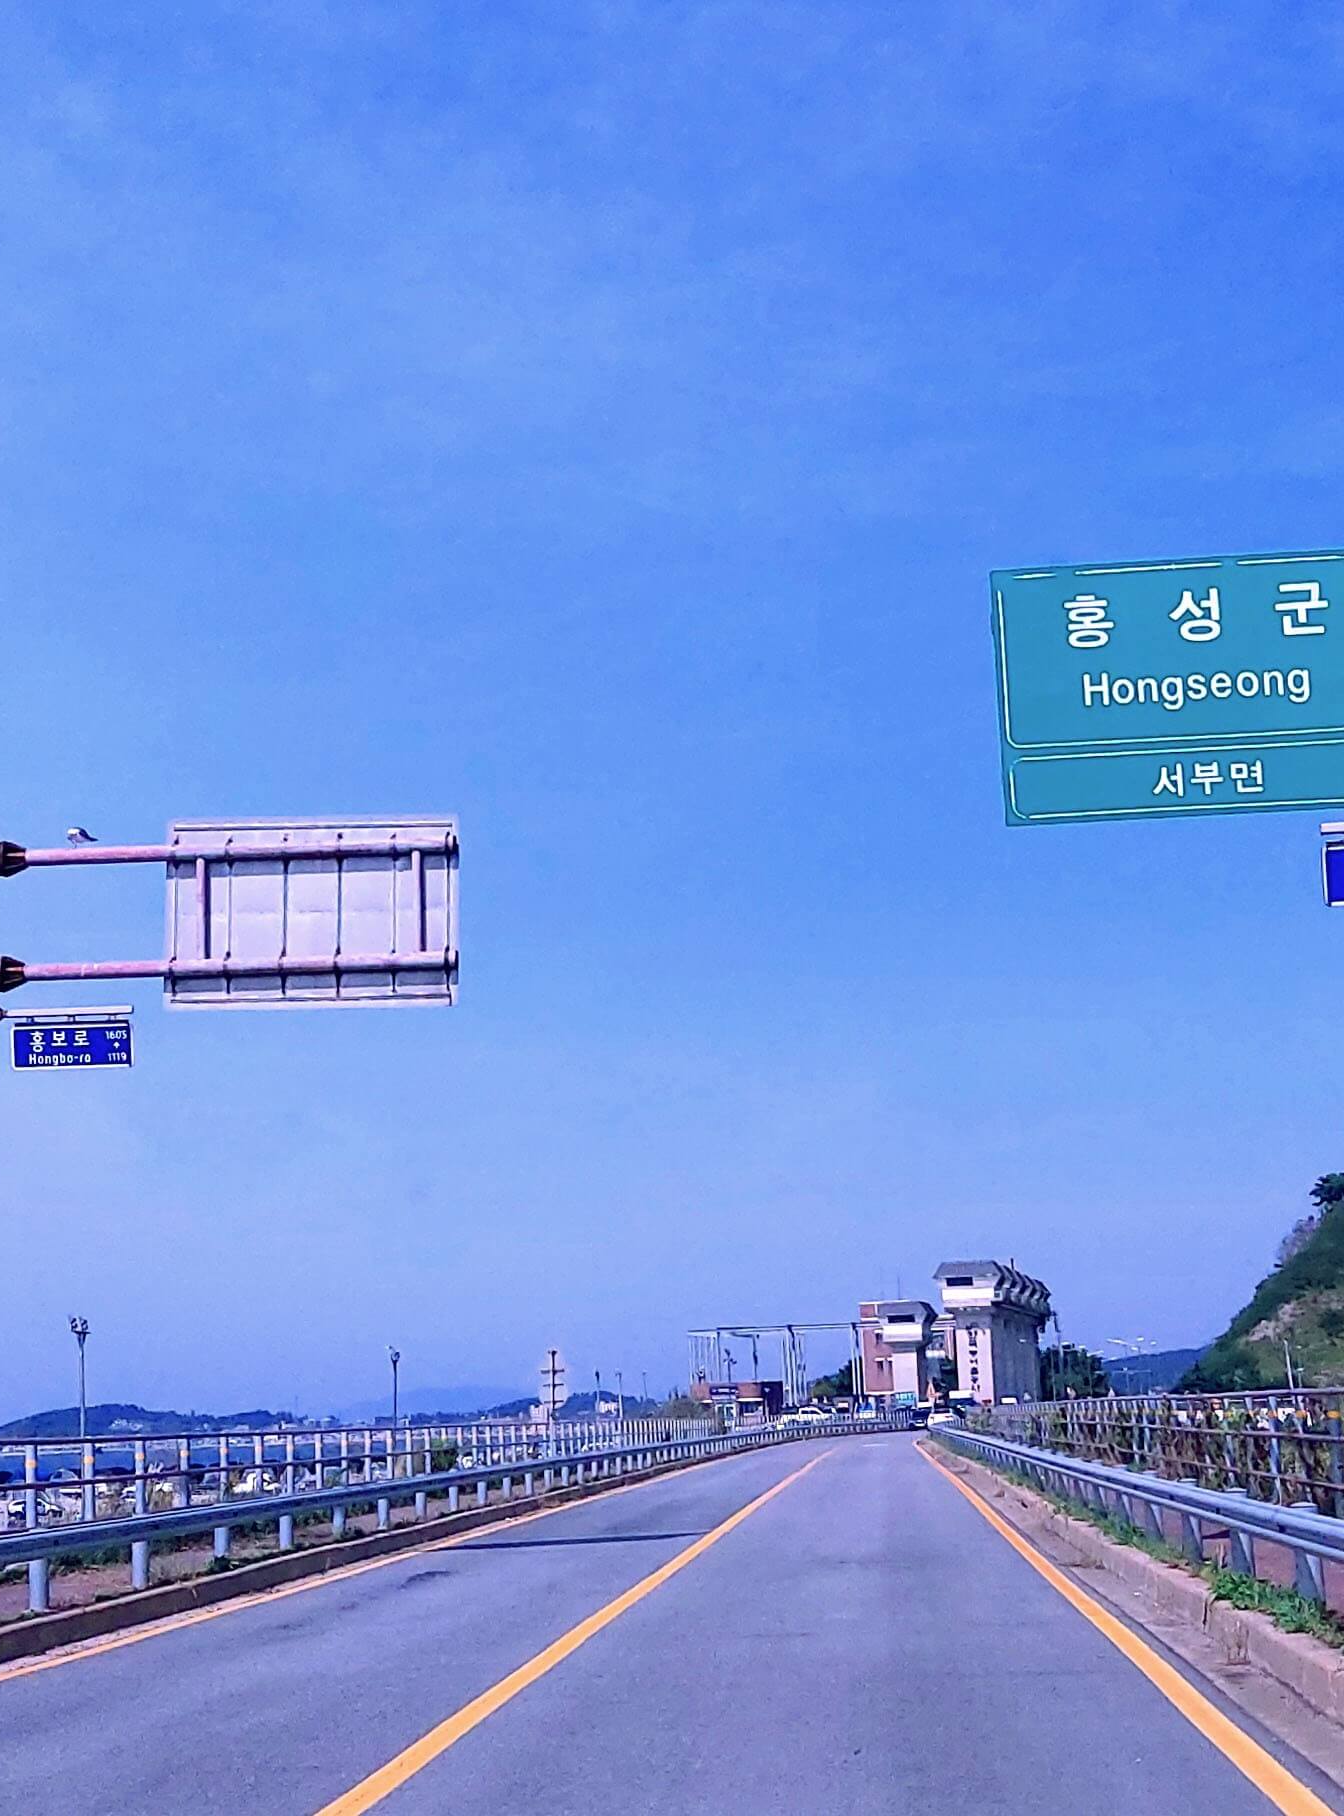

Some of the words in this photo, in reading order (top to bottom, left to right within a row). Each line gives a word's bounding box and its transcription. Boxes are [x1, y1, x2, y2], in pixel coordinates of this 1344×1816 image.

[1063, 581, 1329, 649] 홍성군
[1083, 667, 1311, 711] Hongseong
[1152, 759, 1265, 797] 서부면
[28, 1053, 91, 1066] Hongbo-ro
[29, 1030, 90, 1053] 홍보로
